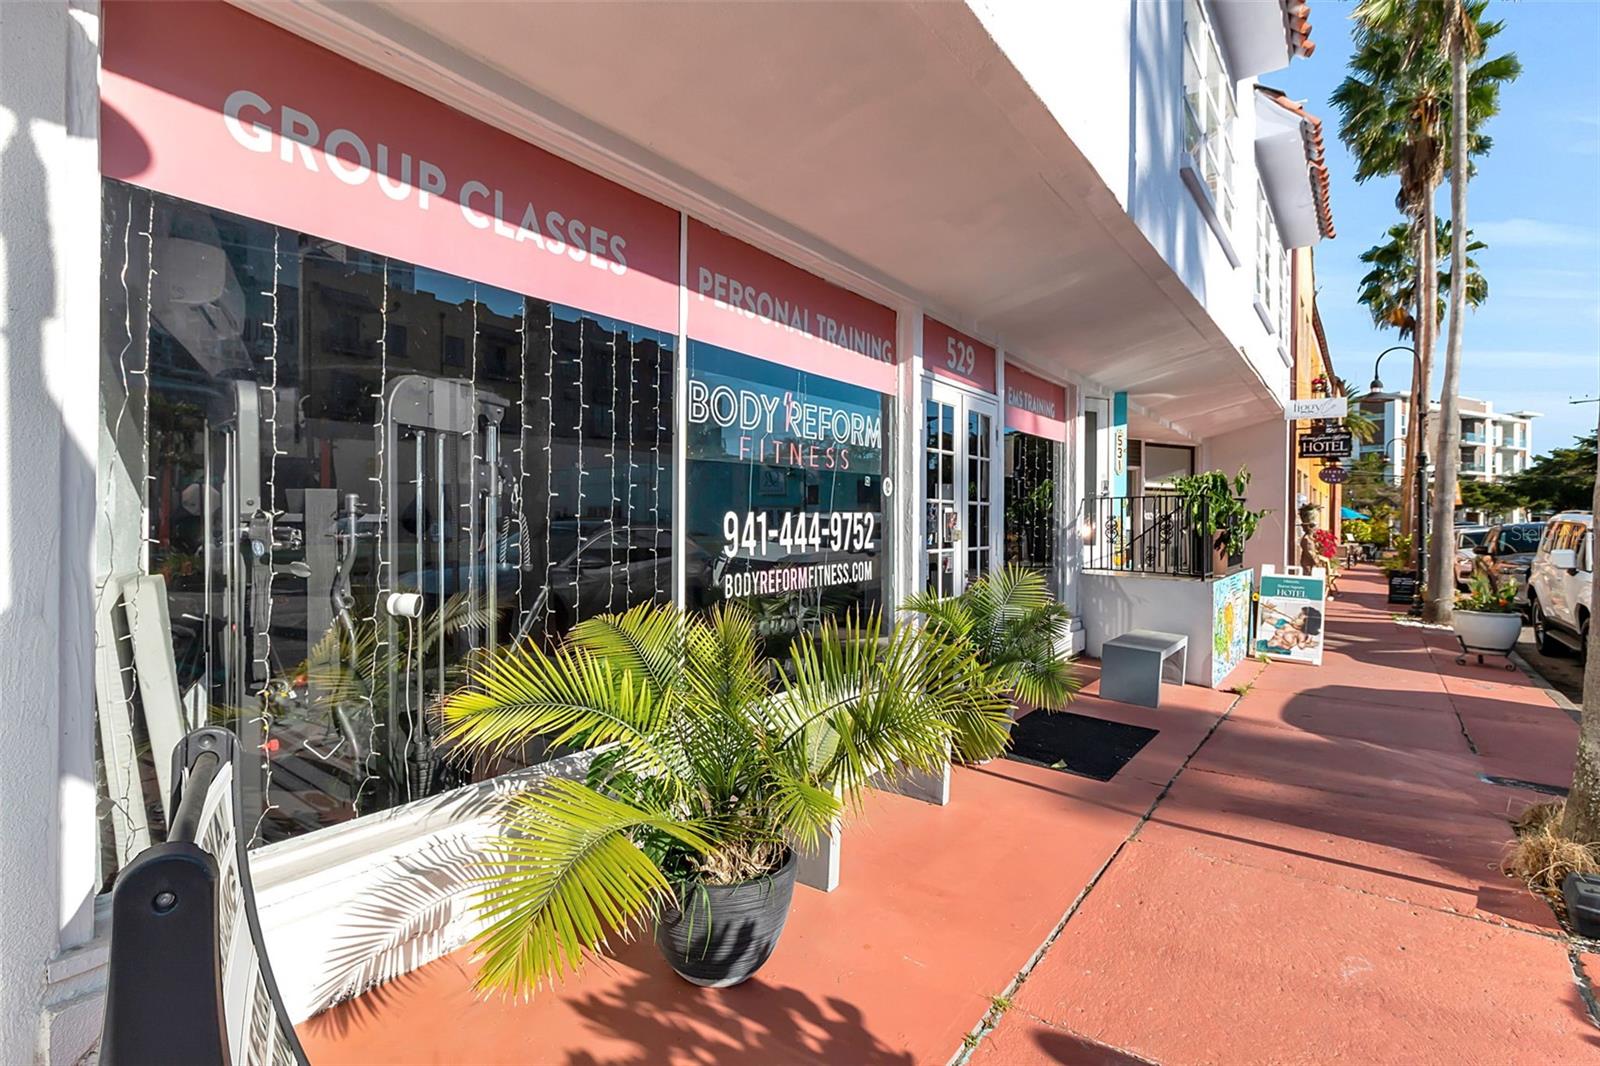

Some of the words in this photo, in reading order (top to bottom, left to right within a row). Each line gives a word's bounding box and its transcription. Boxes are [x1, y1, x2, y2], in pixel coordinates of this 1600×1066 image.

[223, 90, 446, 210] GROUP
[459, 180, 629, 276] CLASSES
[698, 266, 813, 340] PERSONAL
[816, 313, 892, 364] TRAINING
[946, 336, 976, 376] 529
[688, 380, 780, 433] BODY
[784, 392, 882, 449] REFORM
[1008, 386, 1024, 407] EMS
[1023, 391, 1056, 418] TRAINING
[739, 436, 850, 470] FITNESS
[1302, 441, 1349, 452] HOTEL
[723, 510, 875, 558] 941-444-9752
[724, 560, 873, 599] BODYREFORMFITNESS.COM
